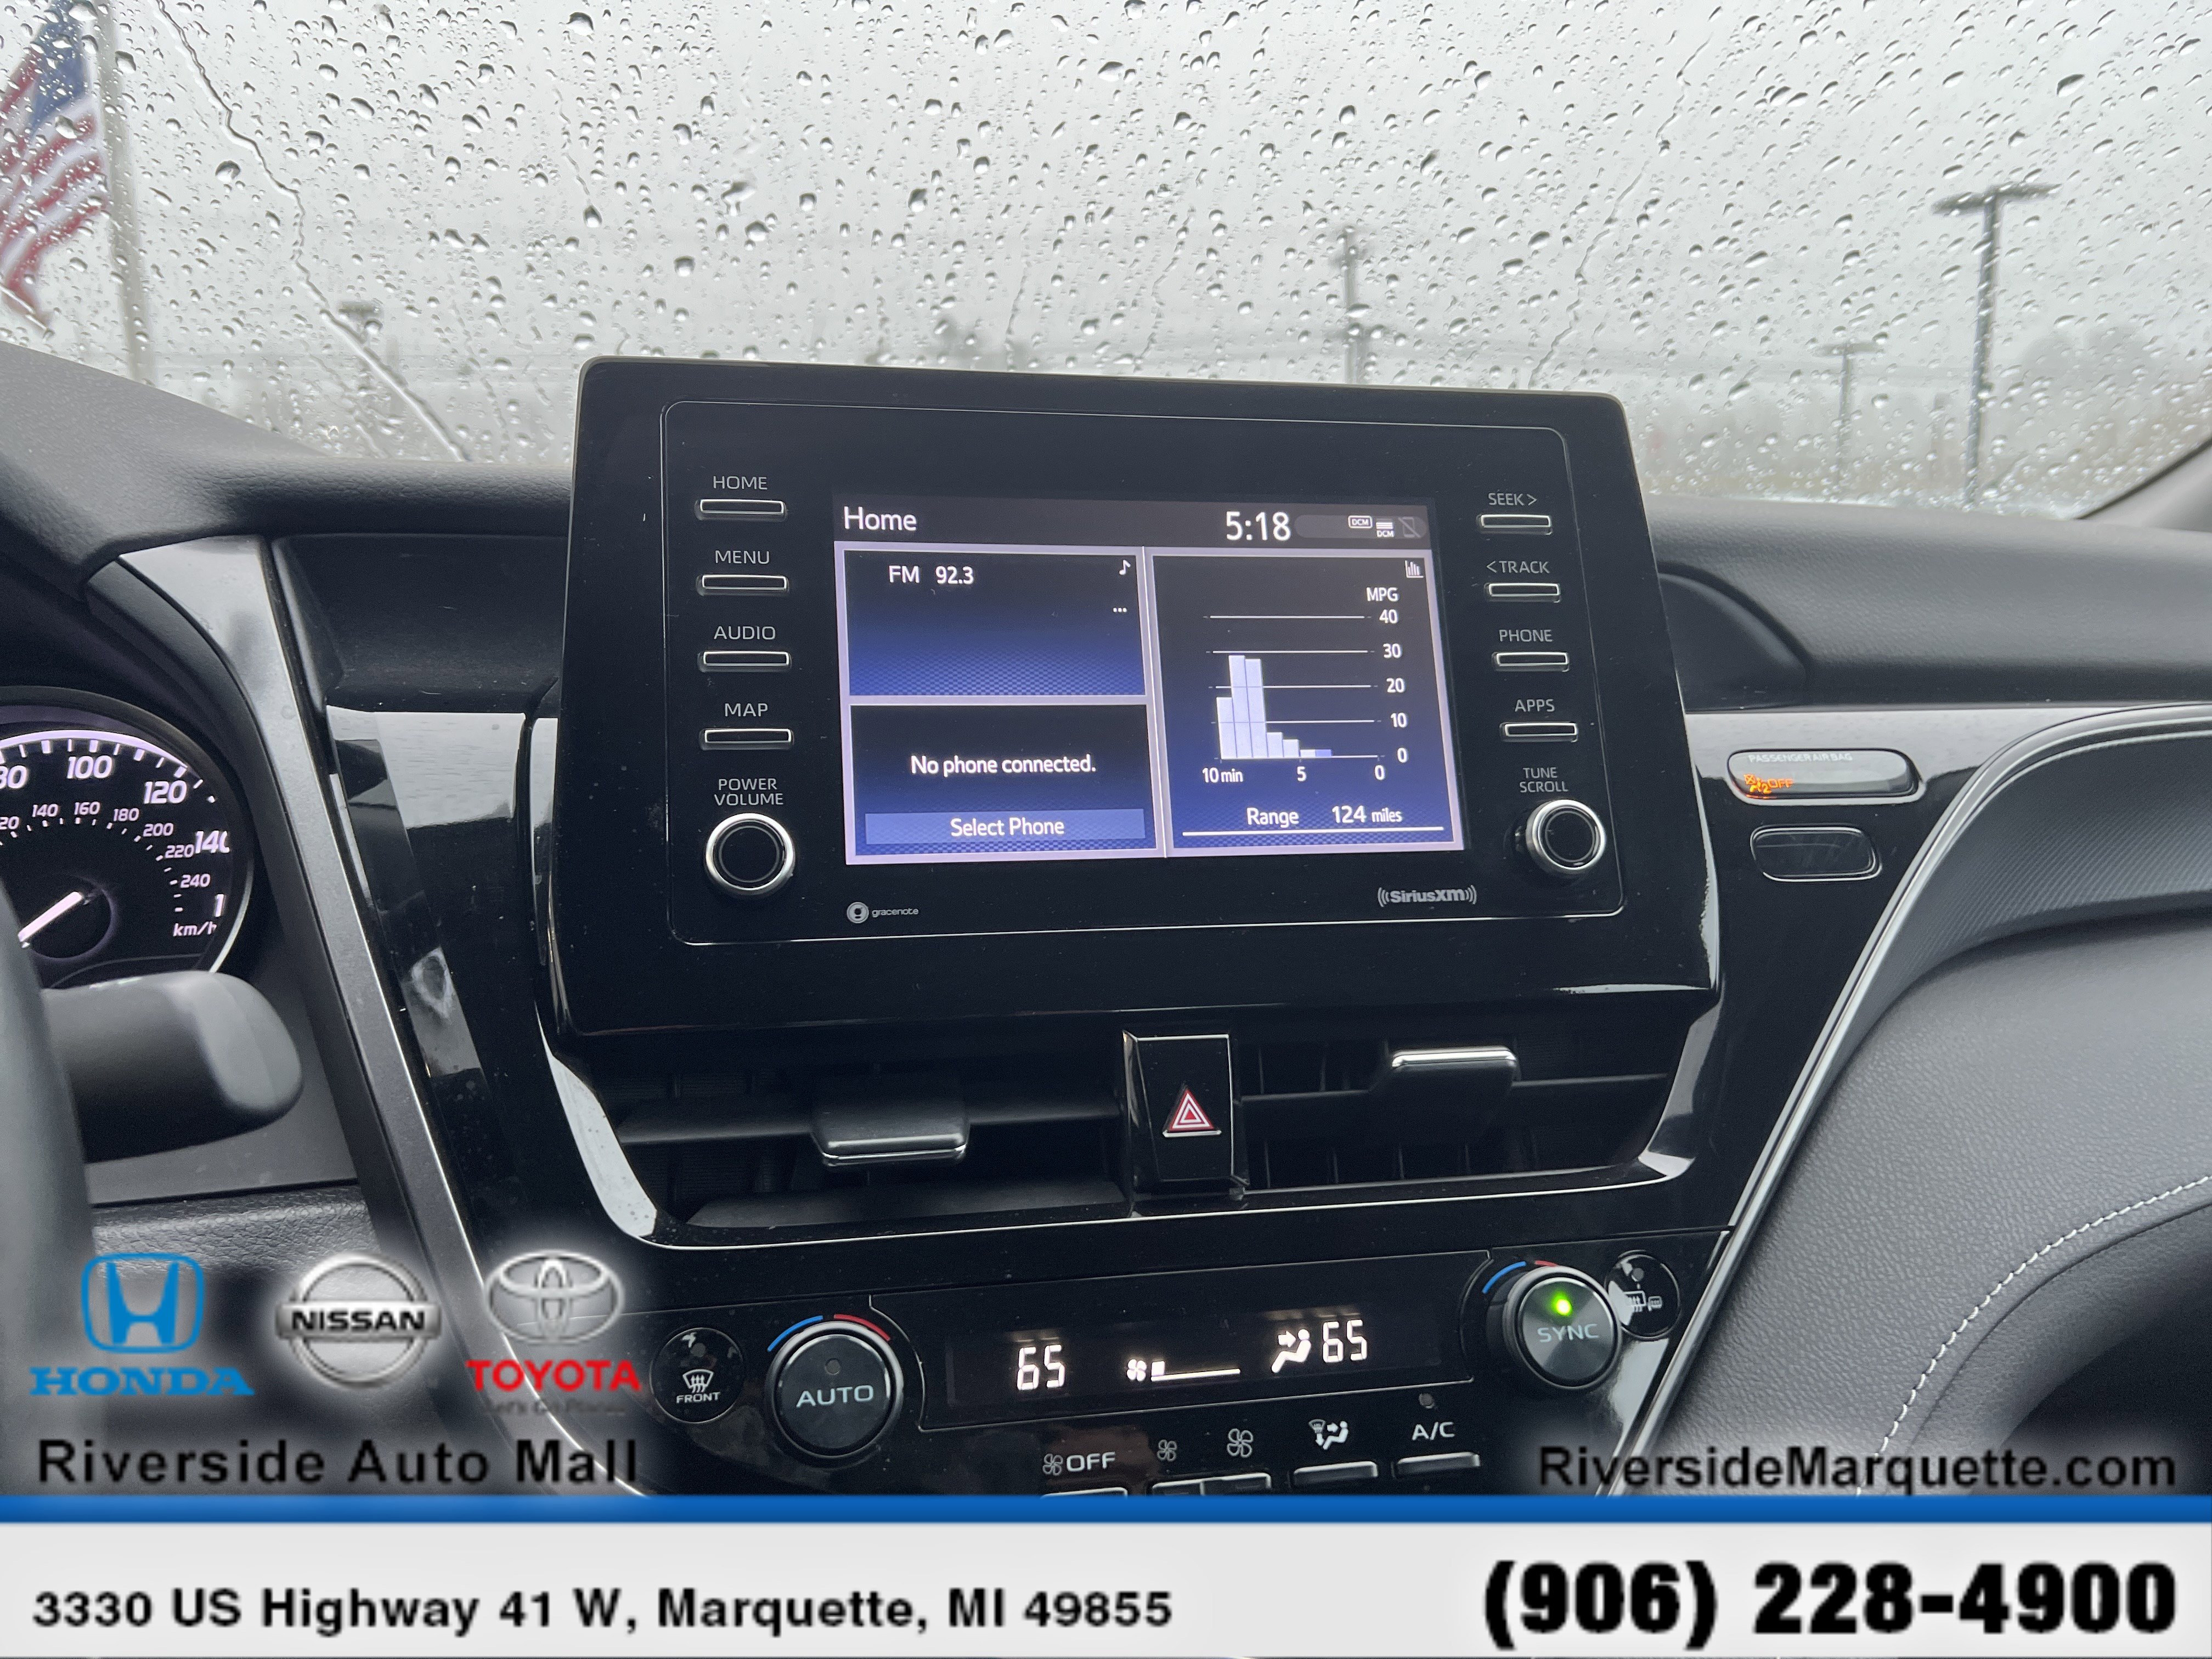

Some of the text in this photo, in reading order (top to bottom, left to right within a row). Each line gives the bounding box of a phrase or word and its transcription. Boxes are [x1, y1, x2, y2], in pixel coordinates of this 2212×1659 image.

[714, 476, 767, 489] HOME
[844, 506, 916, 531] Home
[1351, 518, 1370, 526] DCM
[1227, 512, 1290, 540] 5:18
[1376, 529, 1395, 538] DCM
[715, 551, 769, 564] MENU
[889, 566, 973, 584] FM 92.3
[1367, 588, 1398, 601] MPG
[1380, 610, 1397, 623] 40
[714, 627, 775, 640] AUDIO
[1499, 630, 1552, 642] PHONE
[1384, 644, 1401, 658] 30
[1387, 678, 1404, 692] 20
[725, 703, 768, 716] MAP
[1515, 699, 1554, 712] APPS
[1391, 713, 1407, 727] 10
[1397, 748, 1407, 763] 0
[66, 755, 113, 780] 100
[911, 754, 1096, 777] No phone connected.
[1203, 765, 1385, 783] 10 min 5 0
[1523, 768, 1557, 778] TUNE
[719, 778, 777, 790] POWER
[1520, 781, 1568, 792] SCROLL
[1768, 778, 1794, 788] OFF
[144, 781, 187, 804] 120
[714, 793, 783, 805] VOLUME
[32, 803, 60, 817] 140
[75, 802, 100, 815] 160
[114, 808, 139, 821] 180
[1247, 806, 1402, 828] Range 124 miles
[143, 823, 173, 836] 200
[951, 817, 1064, 836] Select Phone
[165, 844, 195, 858] 220
[180, 873, 211, 888] 240
[872, 909, 918, 917] gracenote
[173, 922, 217, 936] km/h
[1537, 1324, 1599, 1343] SYNC
[1323, 1320, 1367, 1362] 65
[1017, 1345, 1065, 1390] 65
[676, 1392, 721, 1403] FRONT
[797, 1385, 873, 1407] AUTO
[1413, 1422, 1454, 1440] A/C
[1067, 1452, 1115, 1471] OFF
